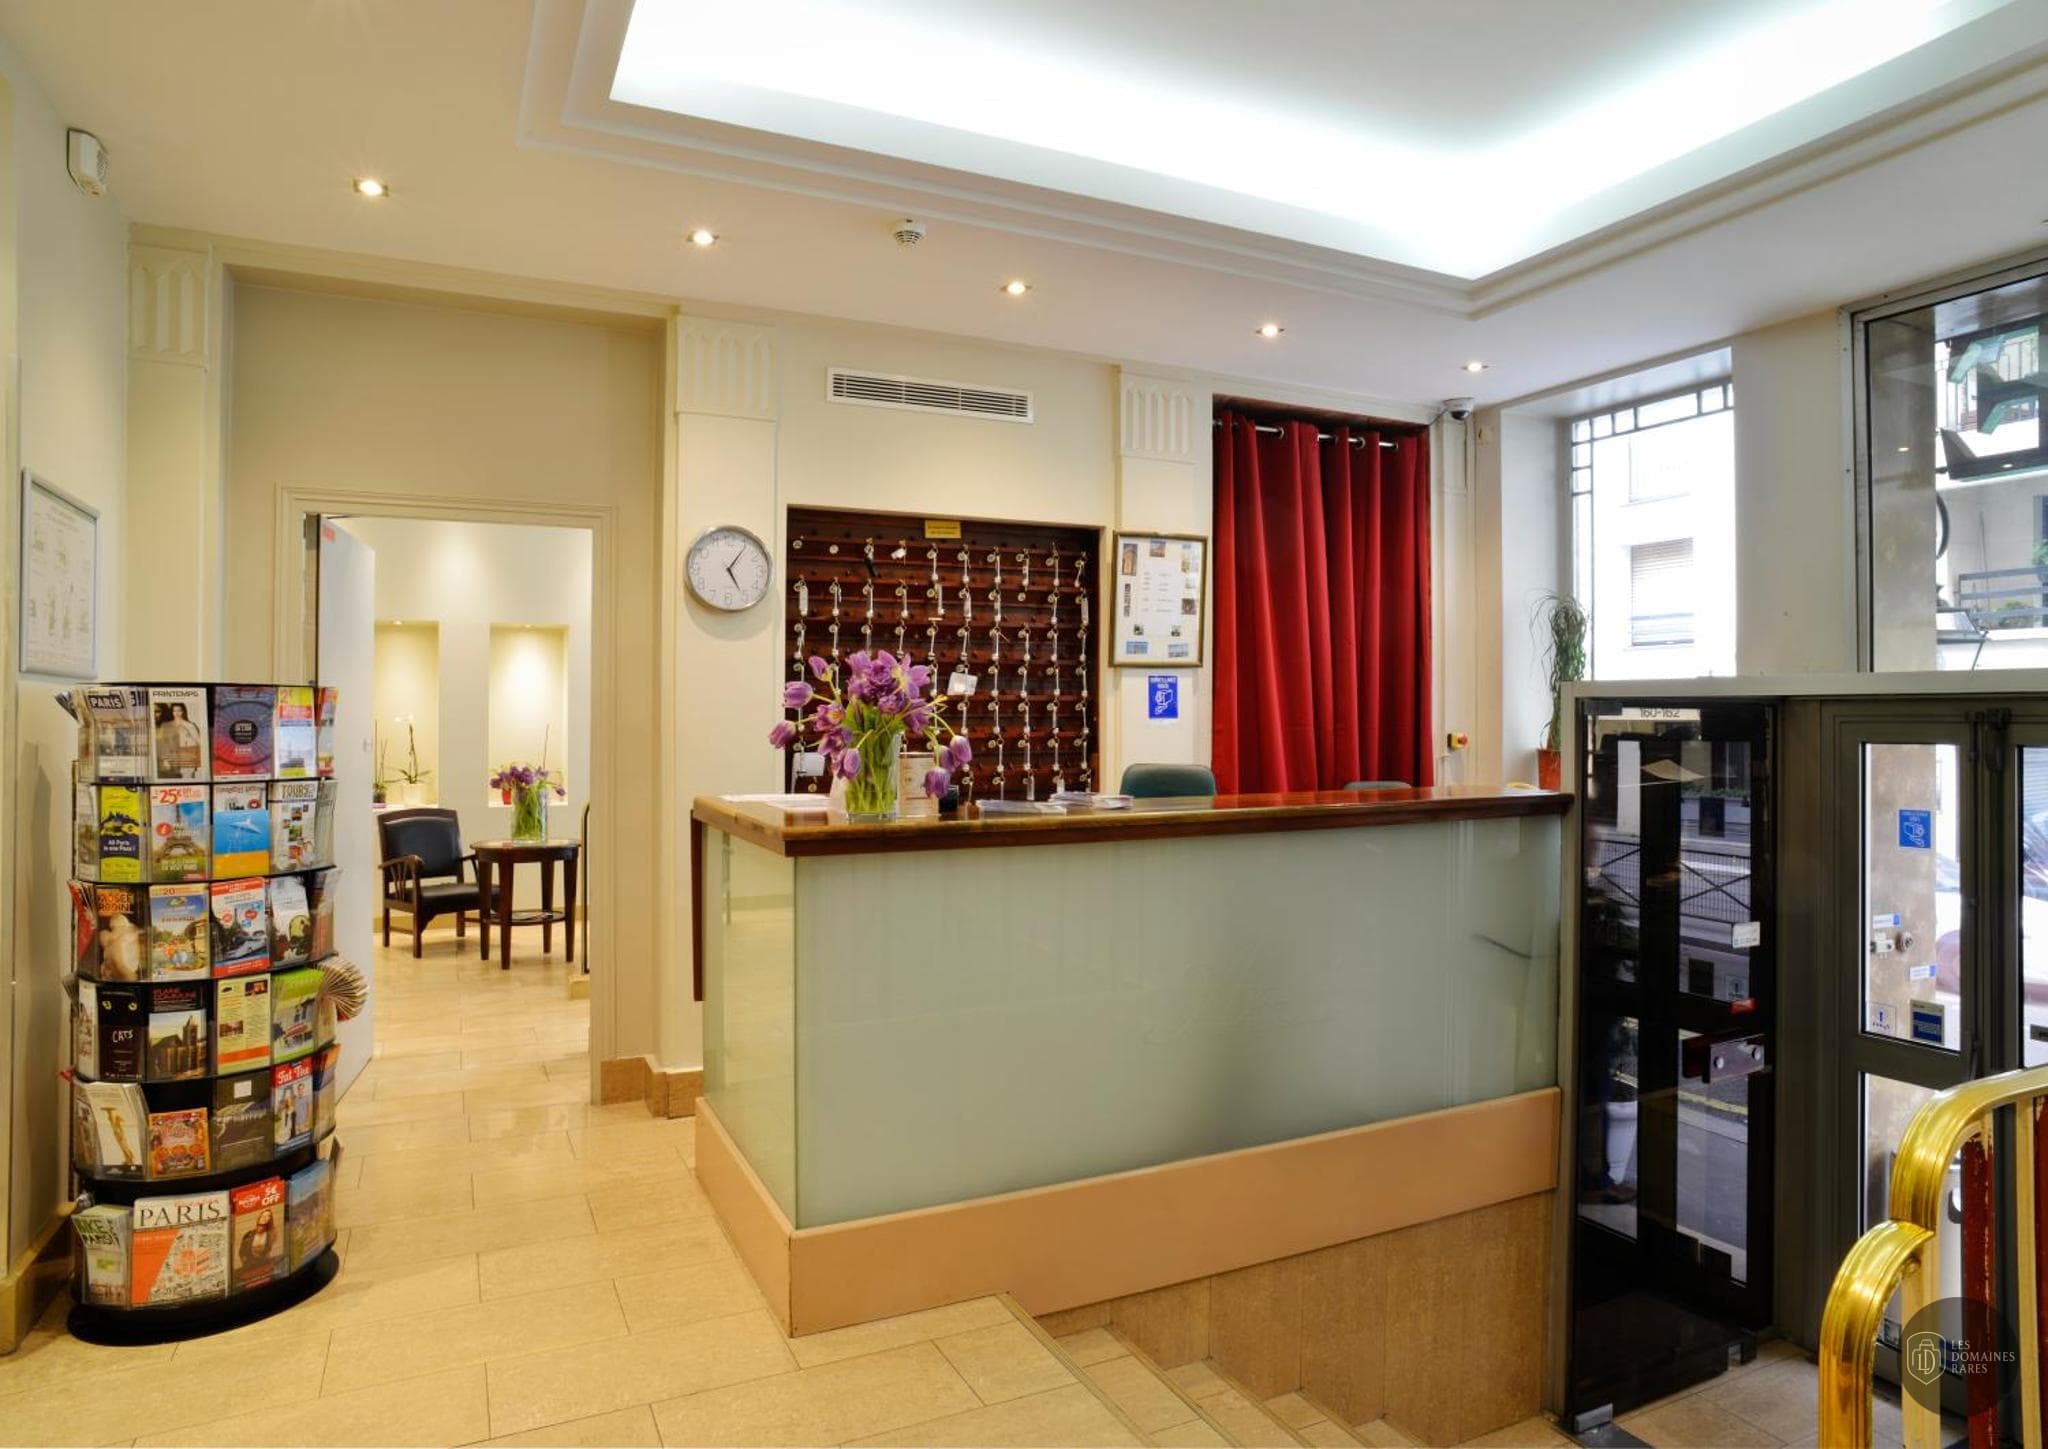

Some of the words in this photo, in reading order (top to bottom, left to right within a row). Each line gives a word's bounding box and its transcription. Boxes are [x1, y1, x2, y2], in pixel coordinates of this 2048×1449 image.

[152, 690, 199, 698] PRINTEMPS
[112, 1029, 134, 1043] CATS
[140, 1199, 220, 1227] PARIS
